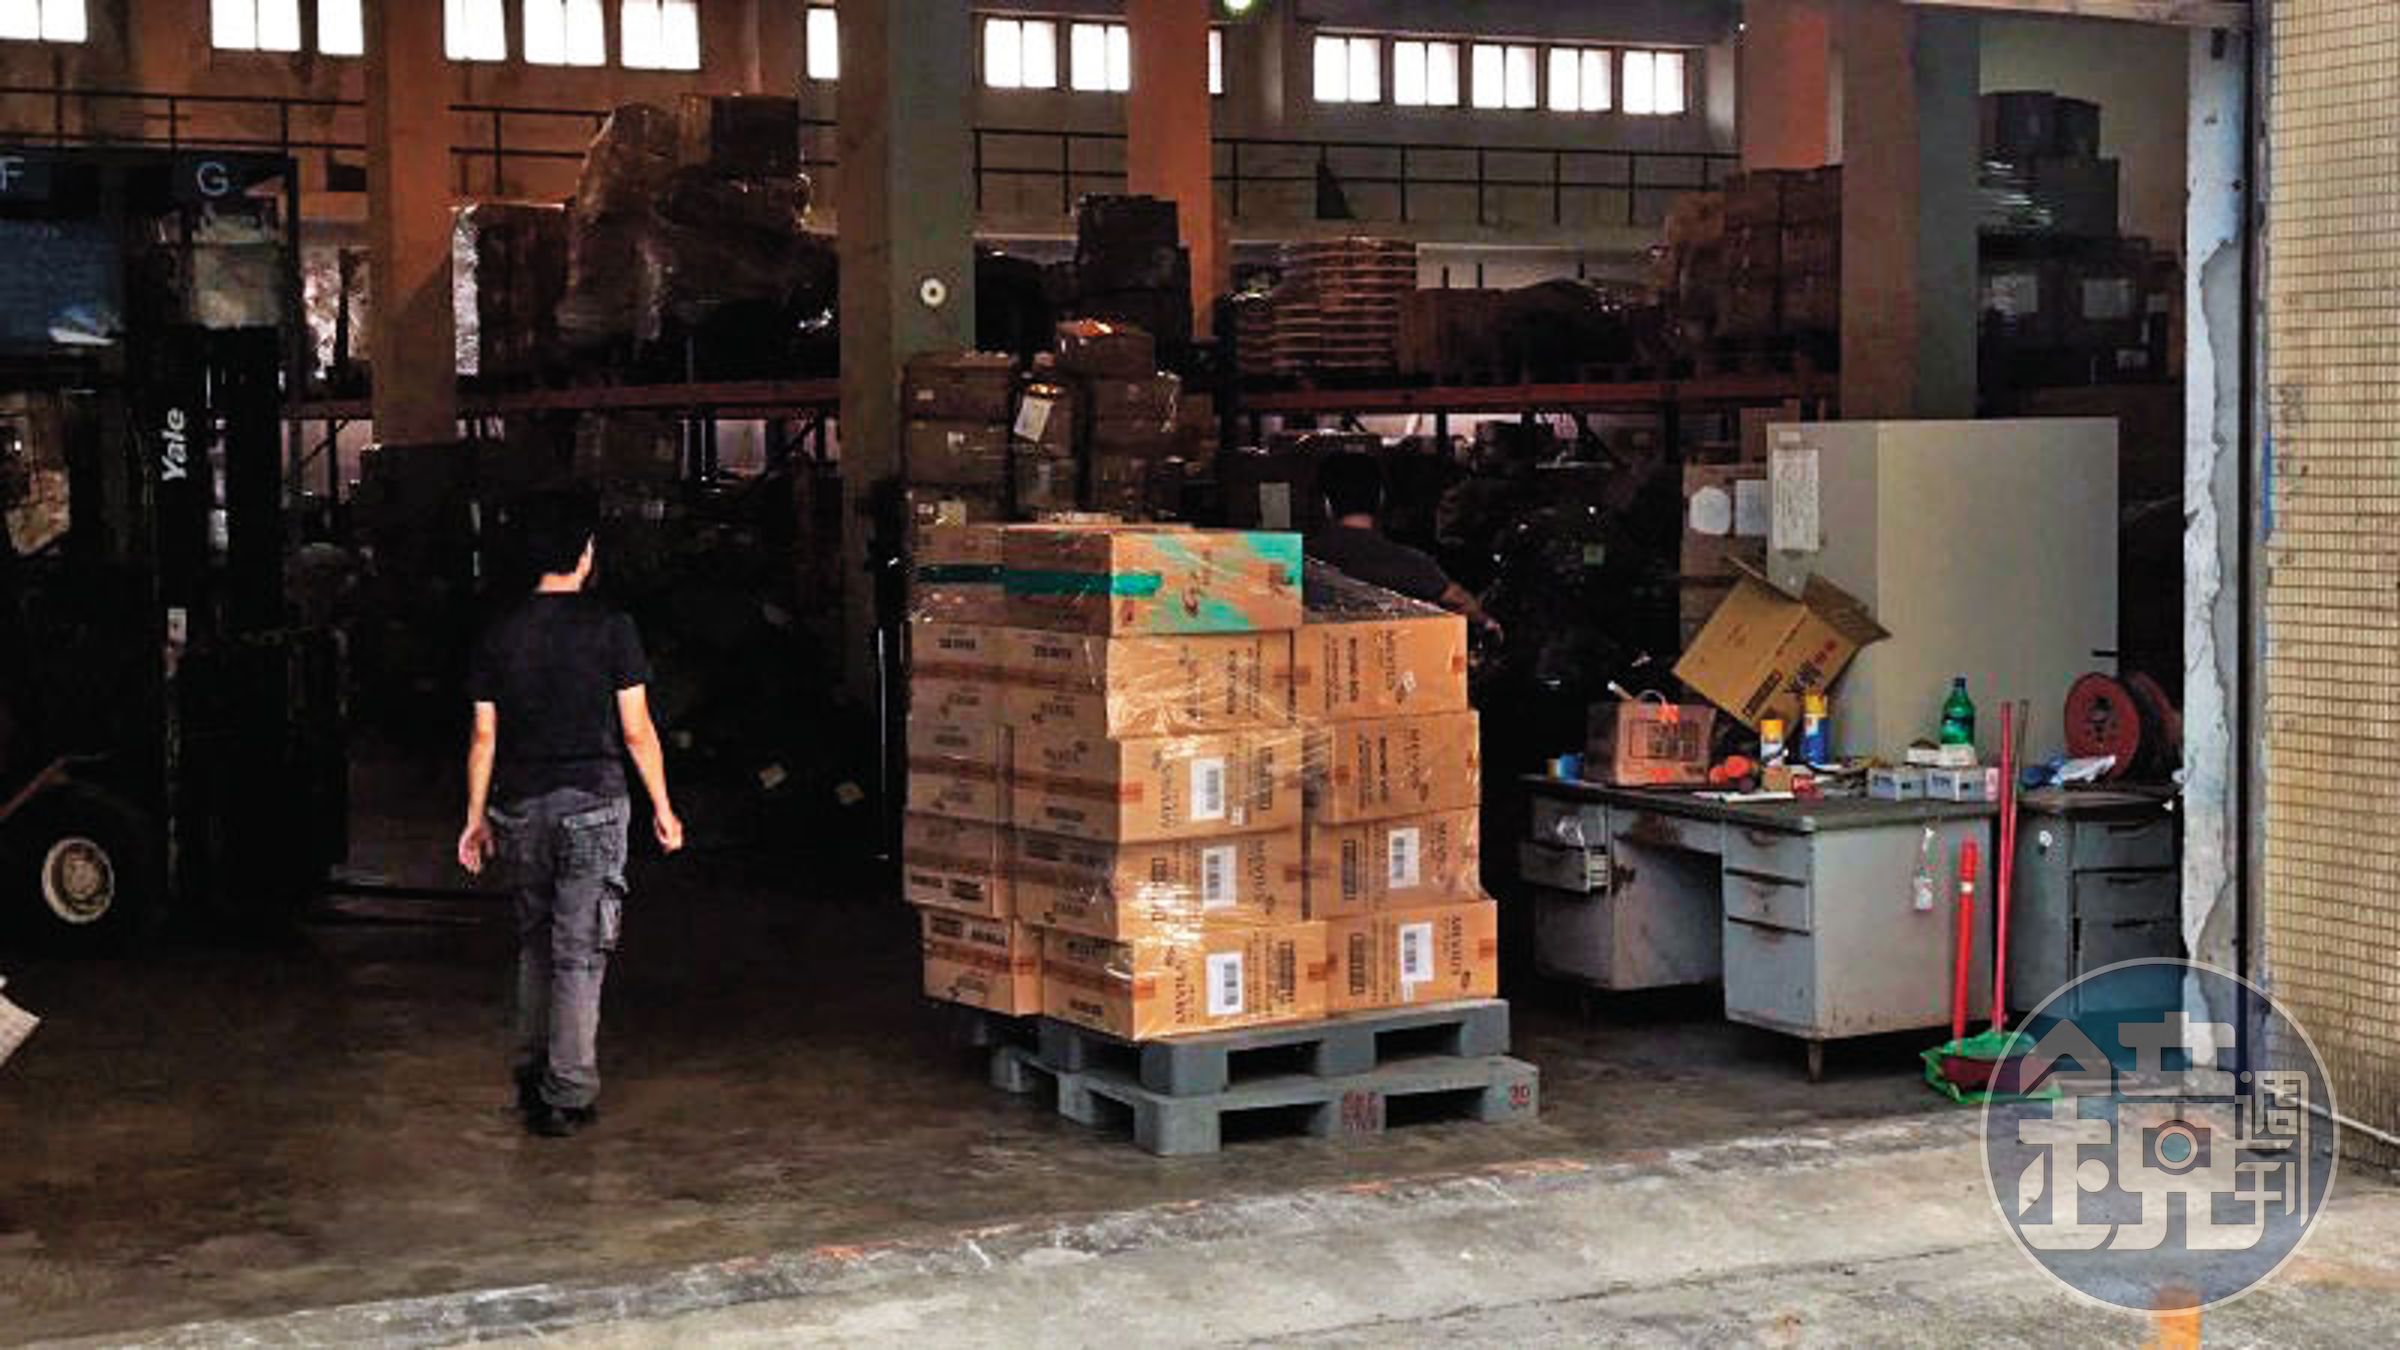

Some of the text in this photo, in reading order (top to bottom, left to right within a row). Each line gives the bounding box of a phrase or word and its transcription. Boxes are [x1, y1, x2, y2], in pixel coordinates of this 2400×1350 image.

[0, 155, 25, 192] F
[197, 161, 229, 196] G
[161, 407, 187, 481] Yale
